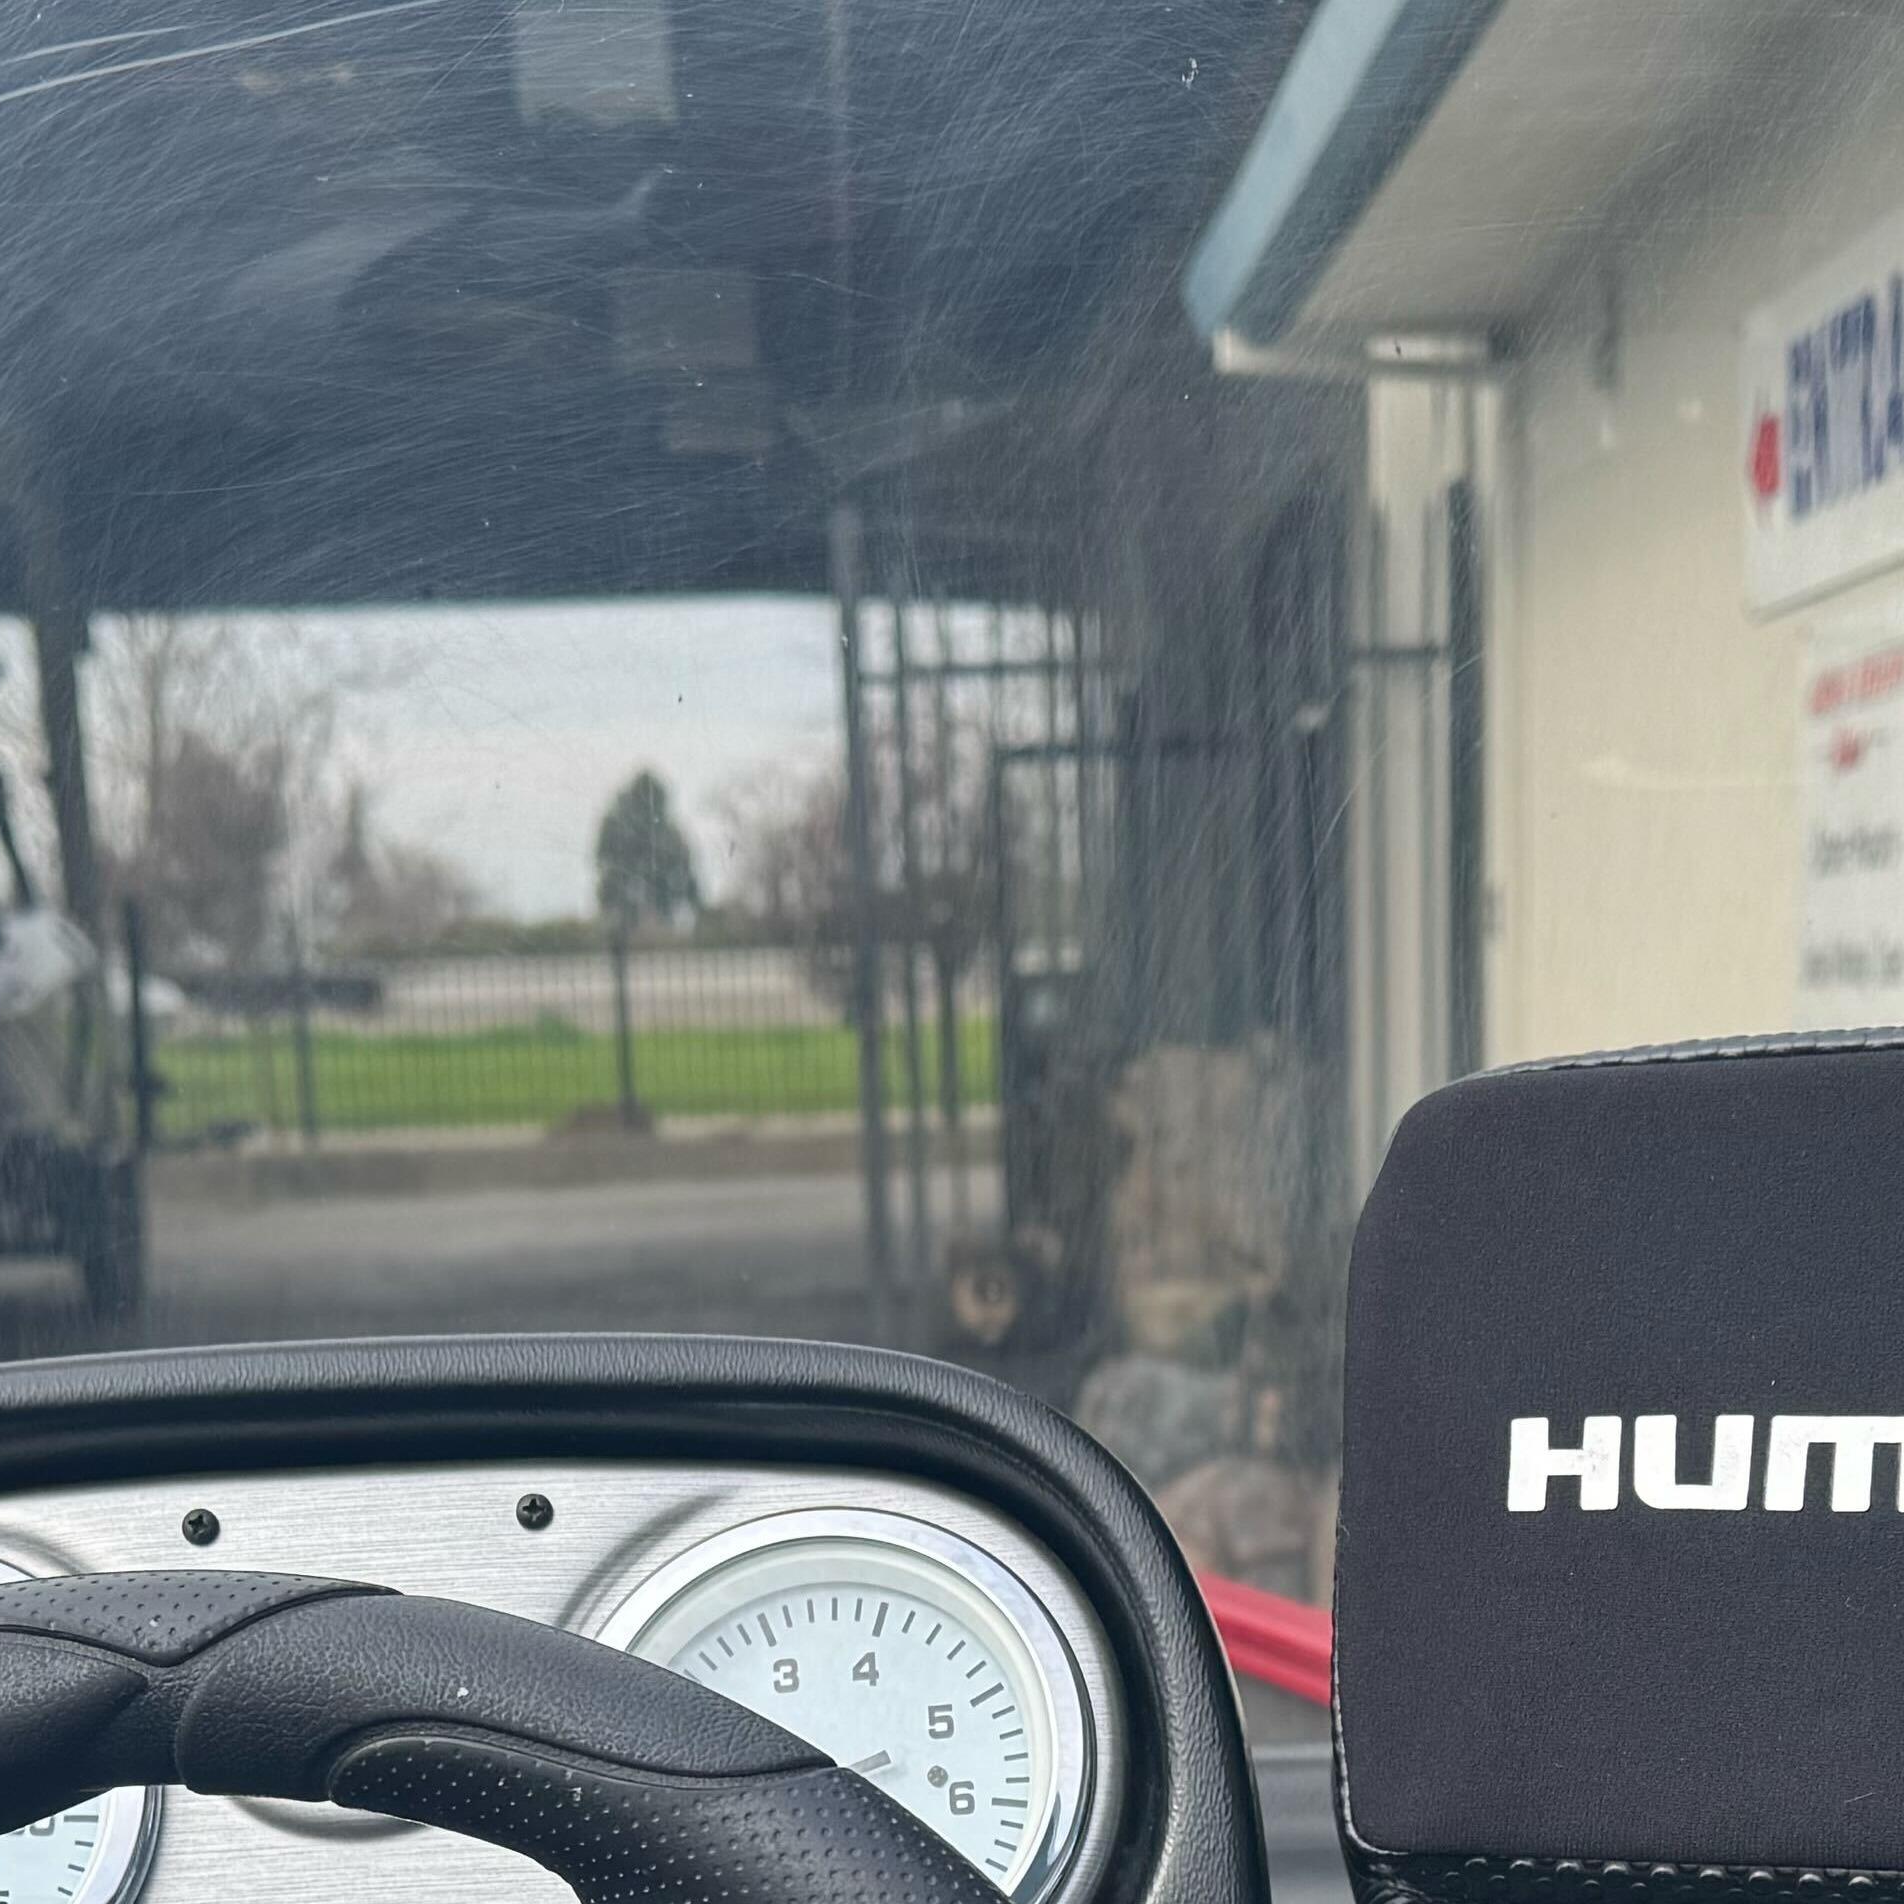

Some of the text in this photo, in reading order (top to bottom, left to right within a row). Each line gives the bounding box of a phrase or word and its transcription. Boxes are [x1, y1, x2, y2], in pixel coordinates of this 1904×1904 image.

[772, 1658, 801, 1693] 3
[851, 1652, 880, 1687] 4
[927, 1704, 955, 1739] 5
[948, 1781, 976, 1816] 6
